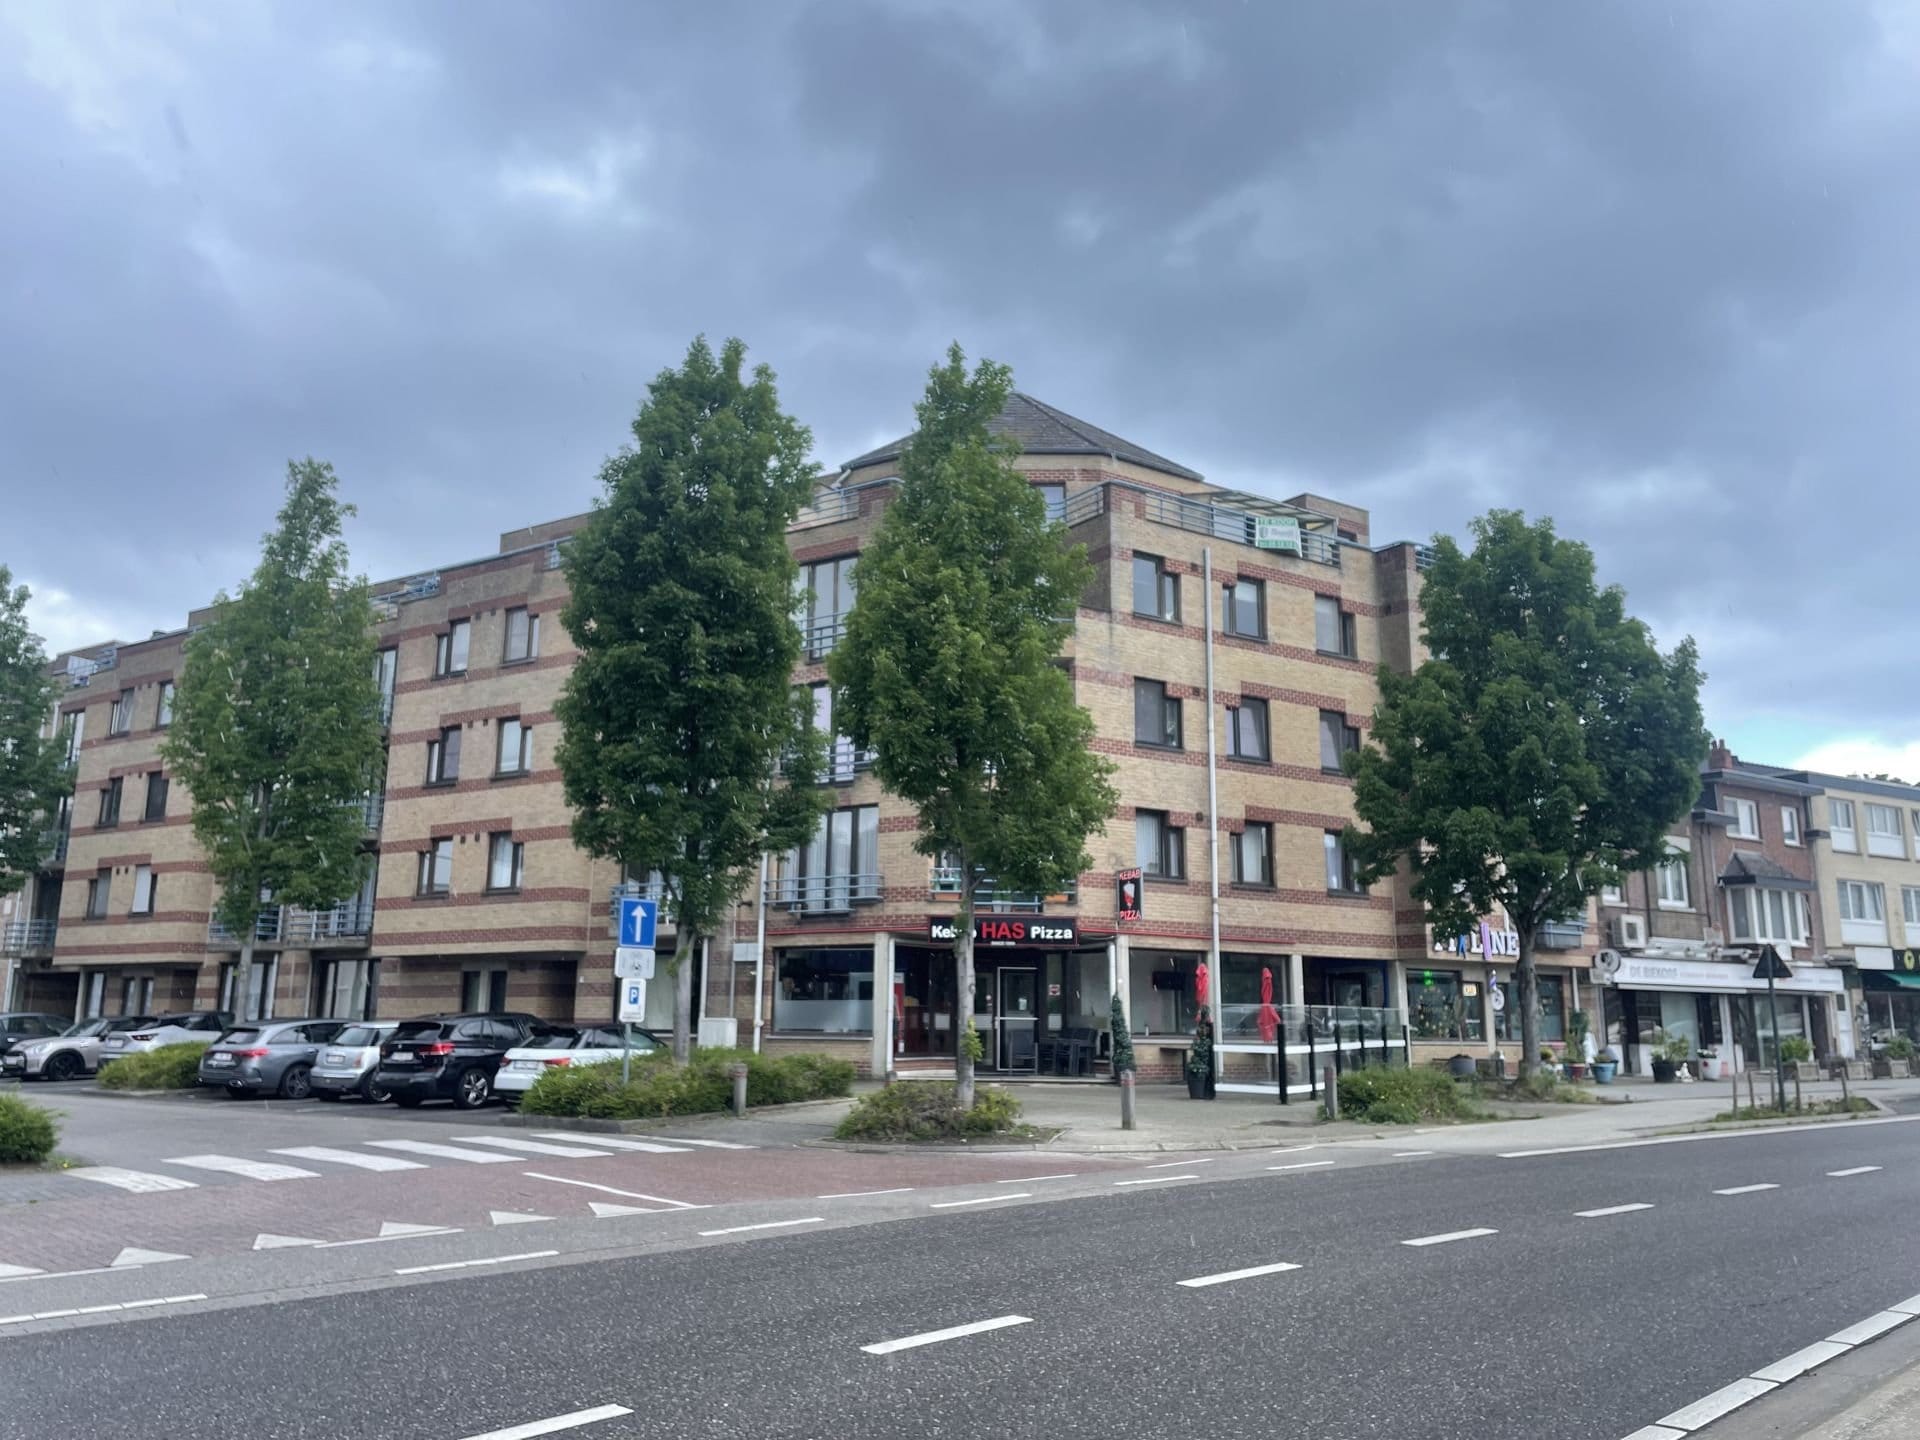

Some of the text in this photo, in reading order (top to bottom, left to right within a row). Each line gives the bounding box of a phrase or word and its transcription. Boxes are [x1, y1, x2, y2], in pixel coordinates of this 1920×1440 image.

[1120, 869, 1140, 880] KEBAB
[1120, 910, 1141, 920] PIZZA
[931, 922, 1073, 939] Keb HAS Pizza
